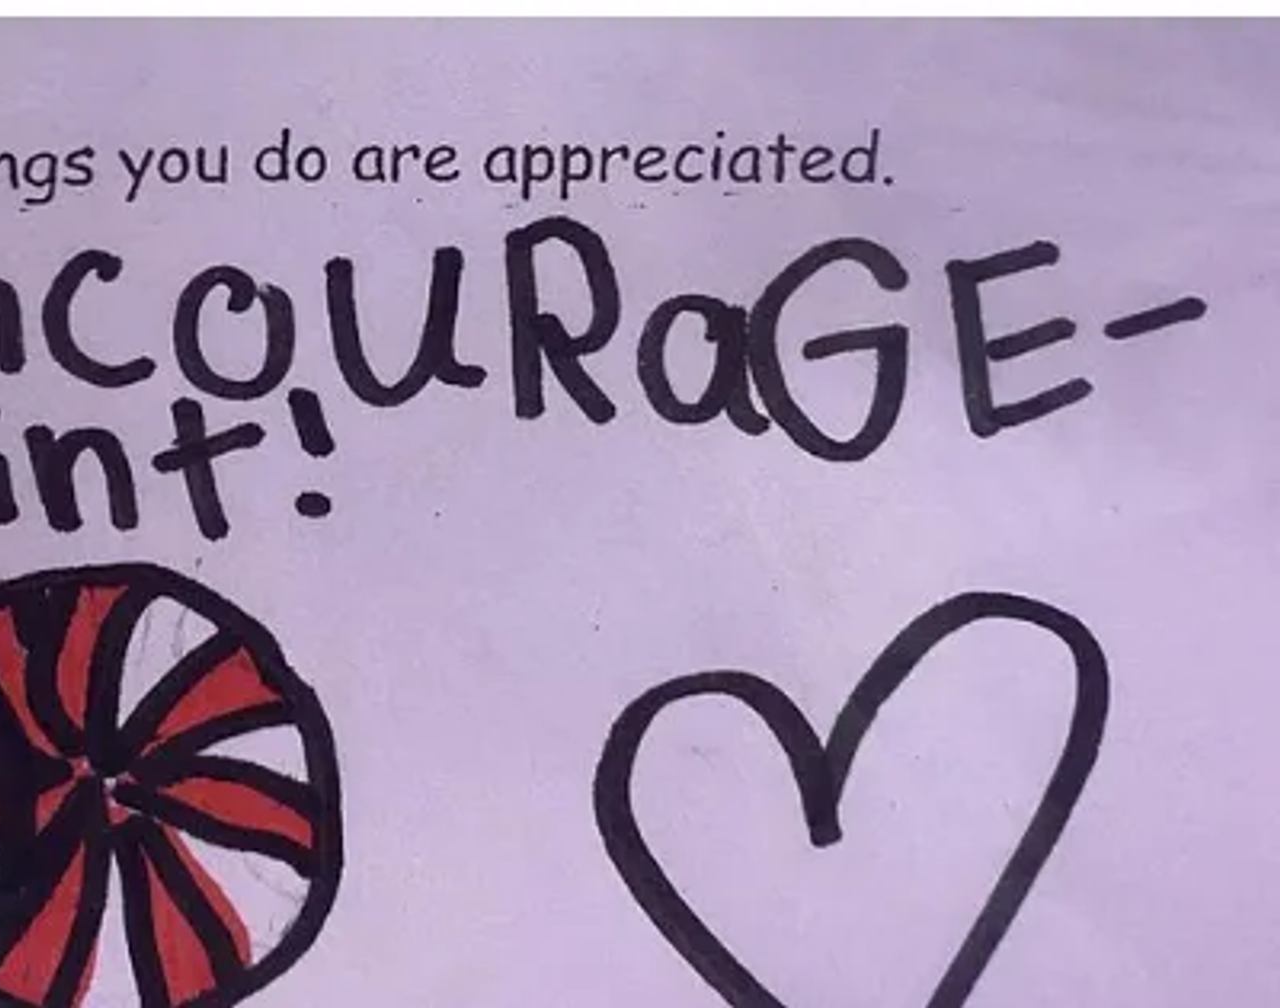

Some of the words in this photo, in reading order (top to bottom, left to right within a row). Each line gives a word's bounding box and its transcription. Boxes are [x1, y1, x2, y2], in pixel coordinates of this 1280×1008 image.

[118, 145, 228, 203] you
[254, 127, 327, 183] do
[352, 144, 460, 183] are
[483, 128, 894, 202] appreciated.
